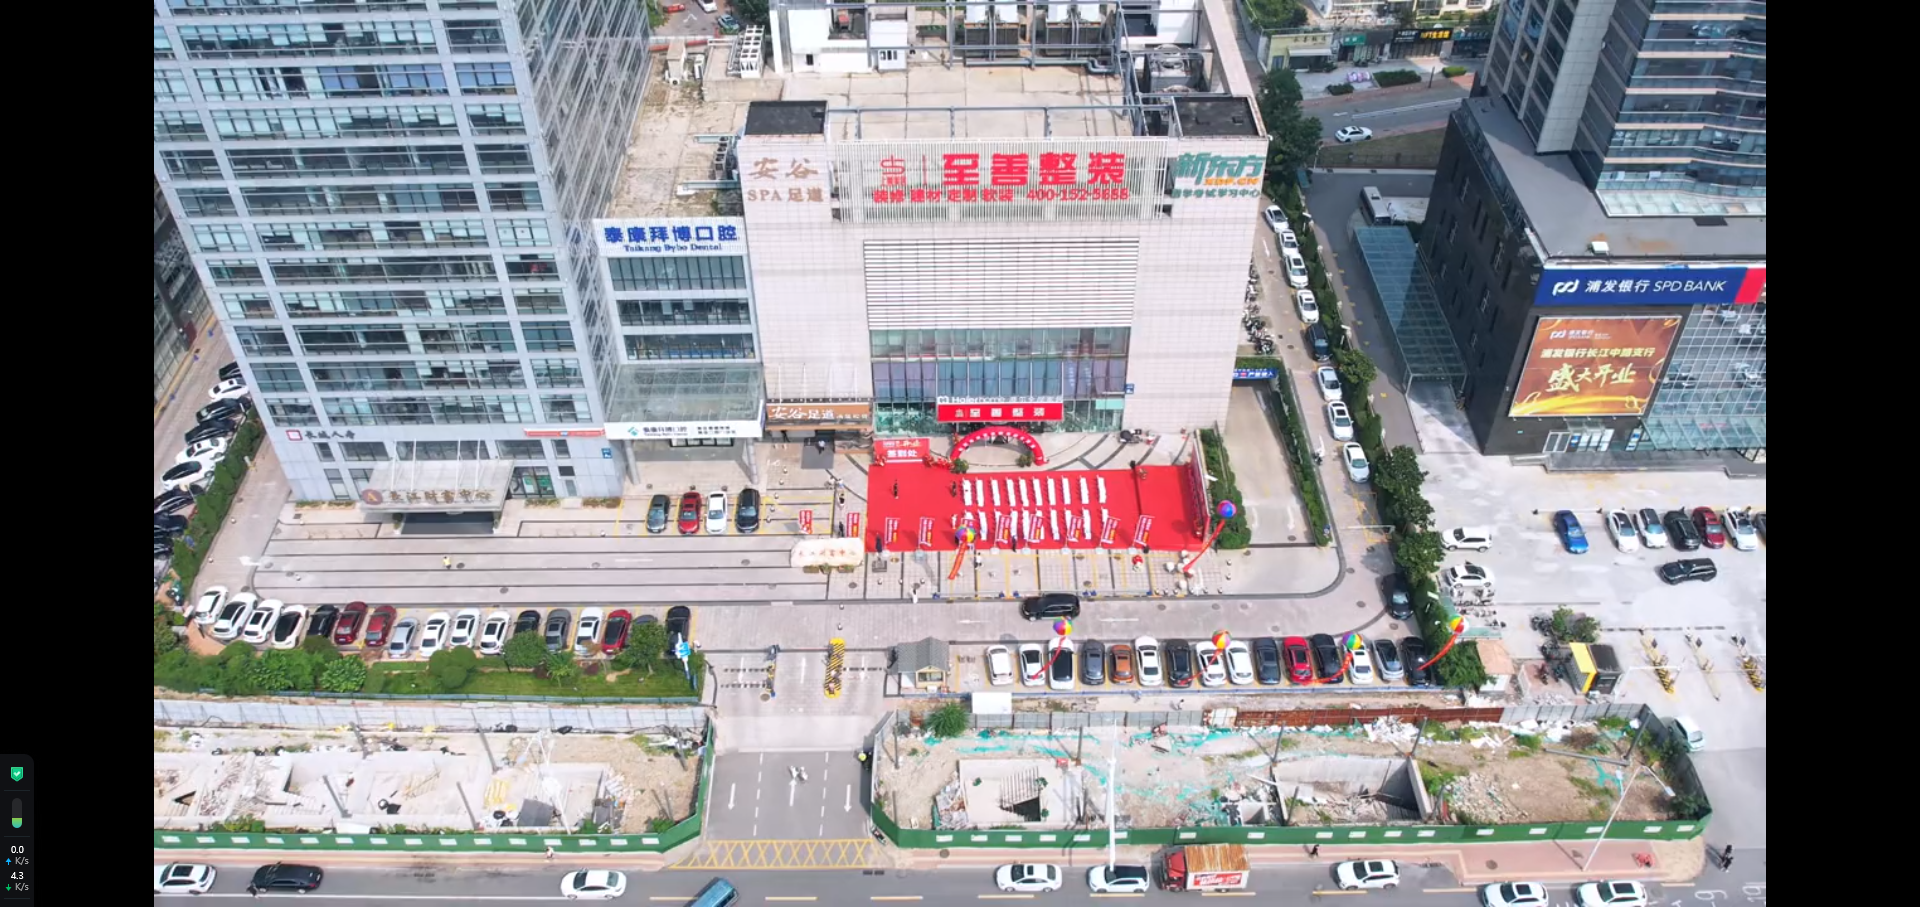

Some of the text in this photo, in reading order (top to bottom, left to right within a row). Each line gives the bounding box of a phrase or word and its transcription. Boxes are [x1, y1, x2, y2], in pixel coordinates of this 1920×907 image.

[748, 157, 819, 179] 安谷
[943, 152, 1126, 185] 至善整装
[1173, 152, 1267, 185] 新东方
[748, 187, 824, 202] SPA 足道
[910, 188, 943, 202] 建材
[604, 225, 738, 243] 泰康拜博口腔
[624, 242, 722, 253] Taikang Bybo Dental
[1584, 279, 1728, 293] 浦发银行 SPD BANK
[1540, 347, 1656, 359] 浦发银行长江中路支行
[1546, 362, 1637, 393] 盛大开业
[770, 406, 835, 420] 安谷足道
